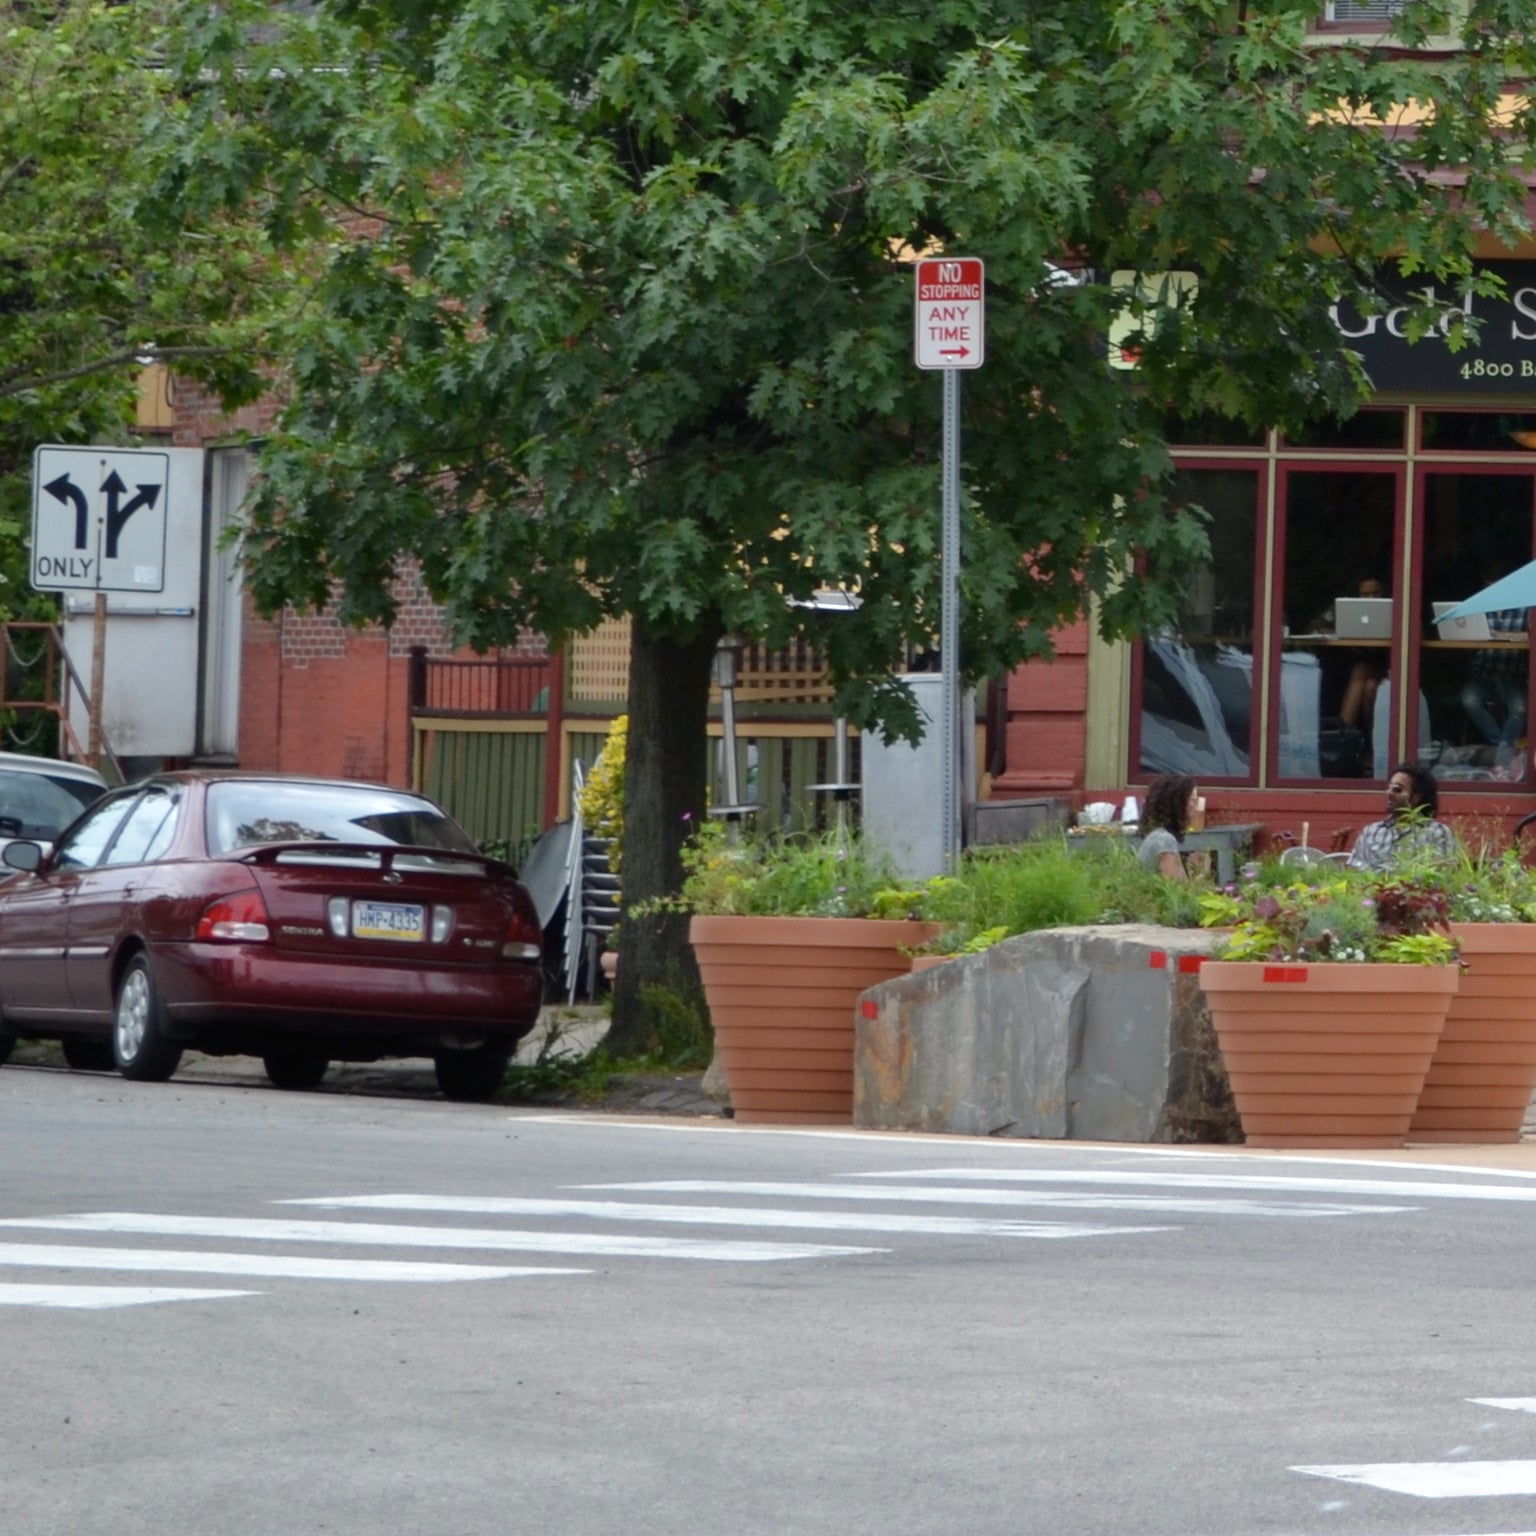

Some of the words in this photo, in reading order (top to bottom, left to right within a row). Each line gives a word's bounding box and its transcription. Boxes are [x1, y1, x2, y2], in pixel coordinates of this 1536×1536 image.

[938, 263, 962, 283] NO
[921, 284, 980, 298] STOPPING
[929, 307, 970, 321] ANY
[1328, 285, 1474, 339] Gold
[928, 326, 971, 341] TIME
[1459, 361, 1514, 379] 4800
[38, 556, 93, 578] ONLY
